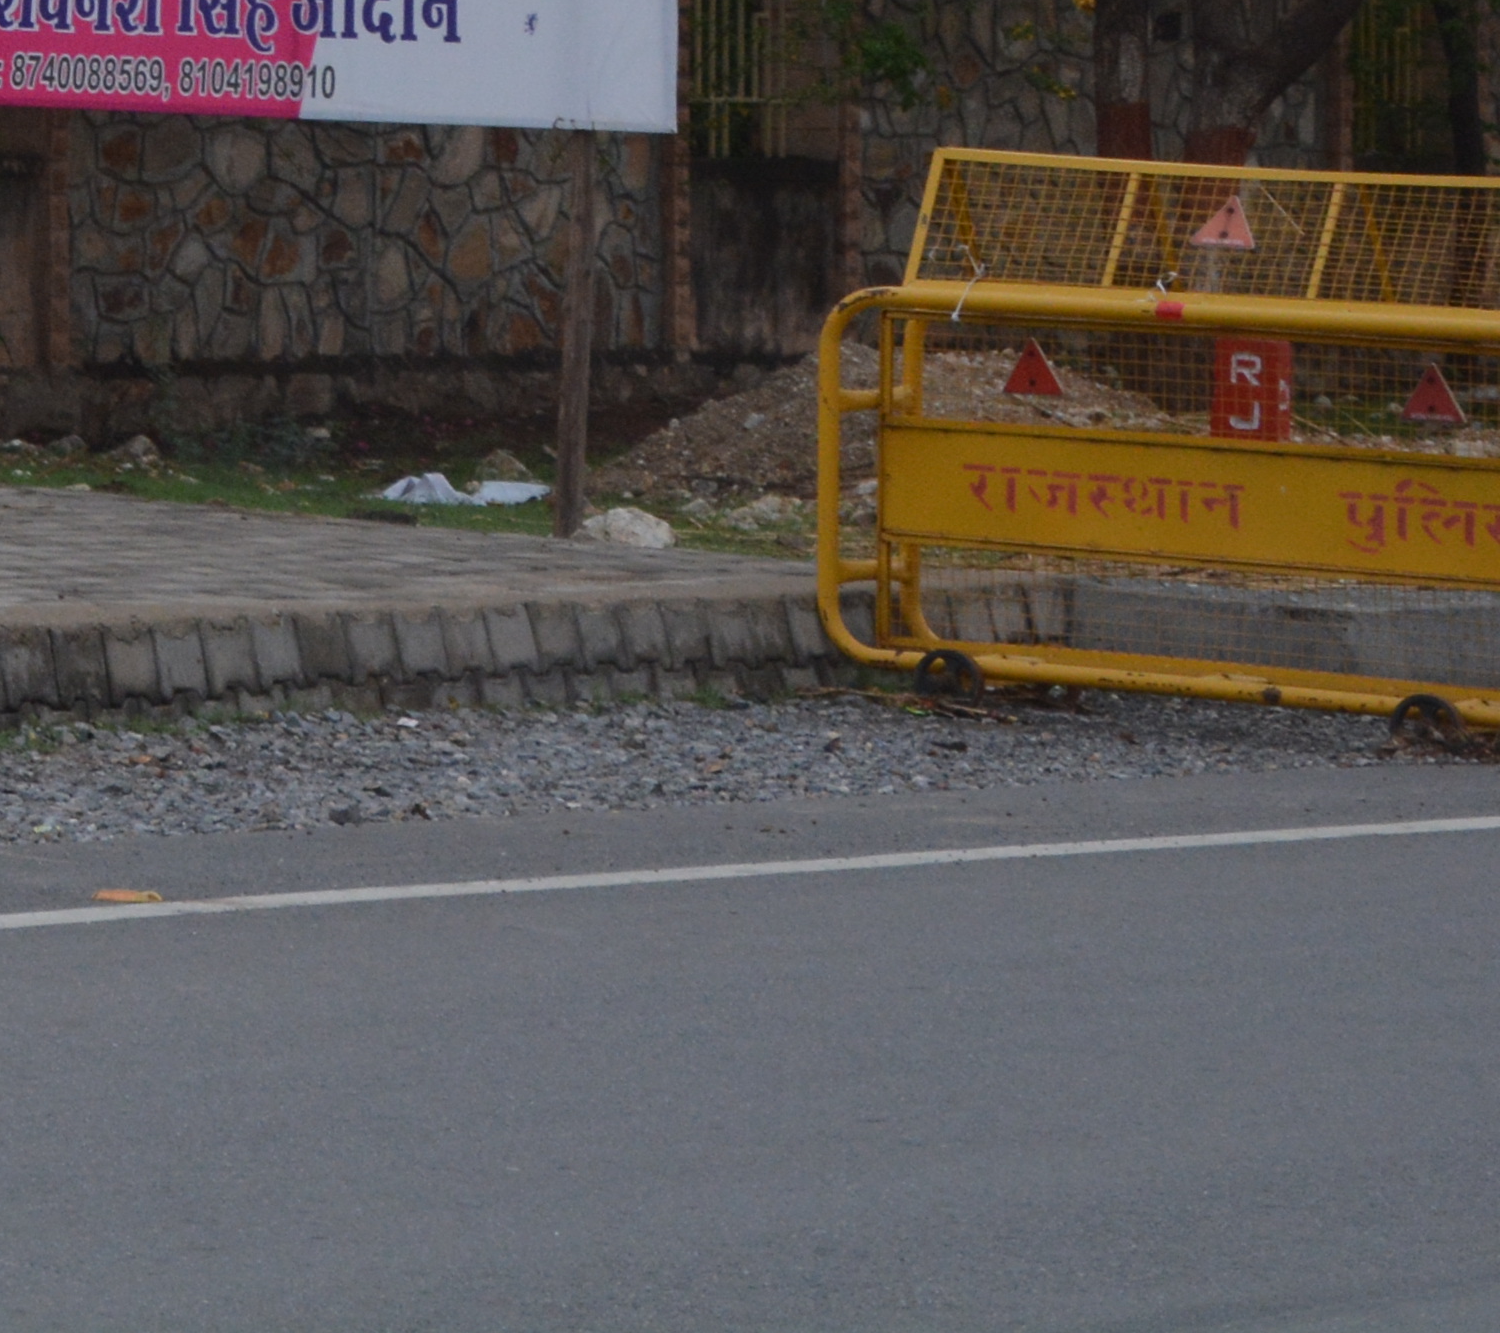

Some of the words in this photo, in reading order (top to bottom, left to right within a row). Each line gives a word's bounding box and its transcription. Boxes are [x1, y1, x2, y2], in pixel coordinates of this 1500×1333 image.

[10, 52, 172, 101] 8740088569,
[178, 58, 338, 101] 8104198910
[962, 462, 1246, 531] राजस्थान
